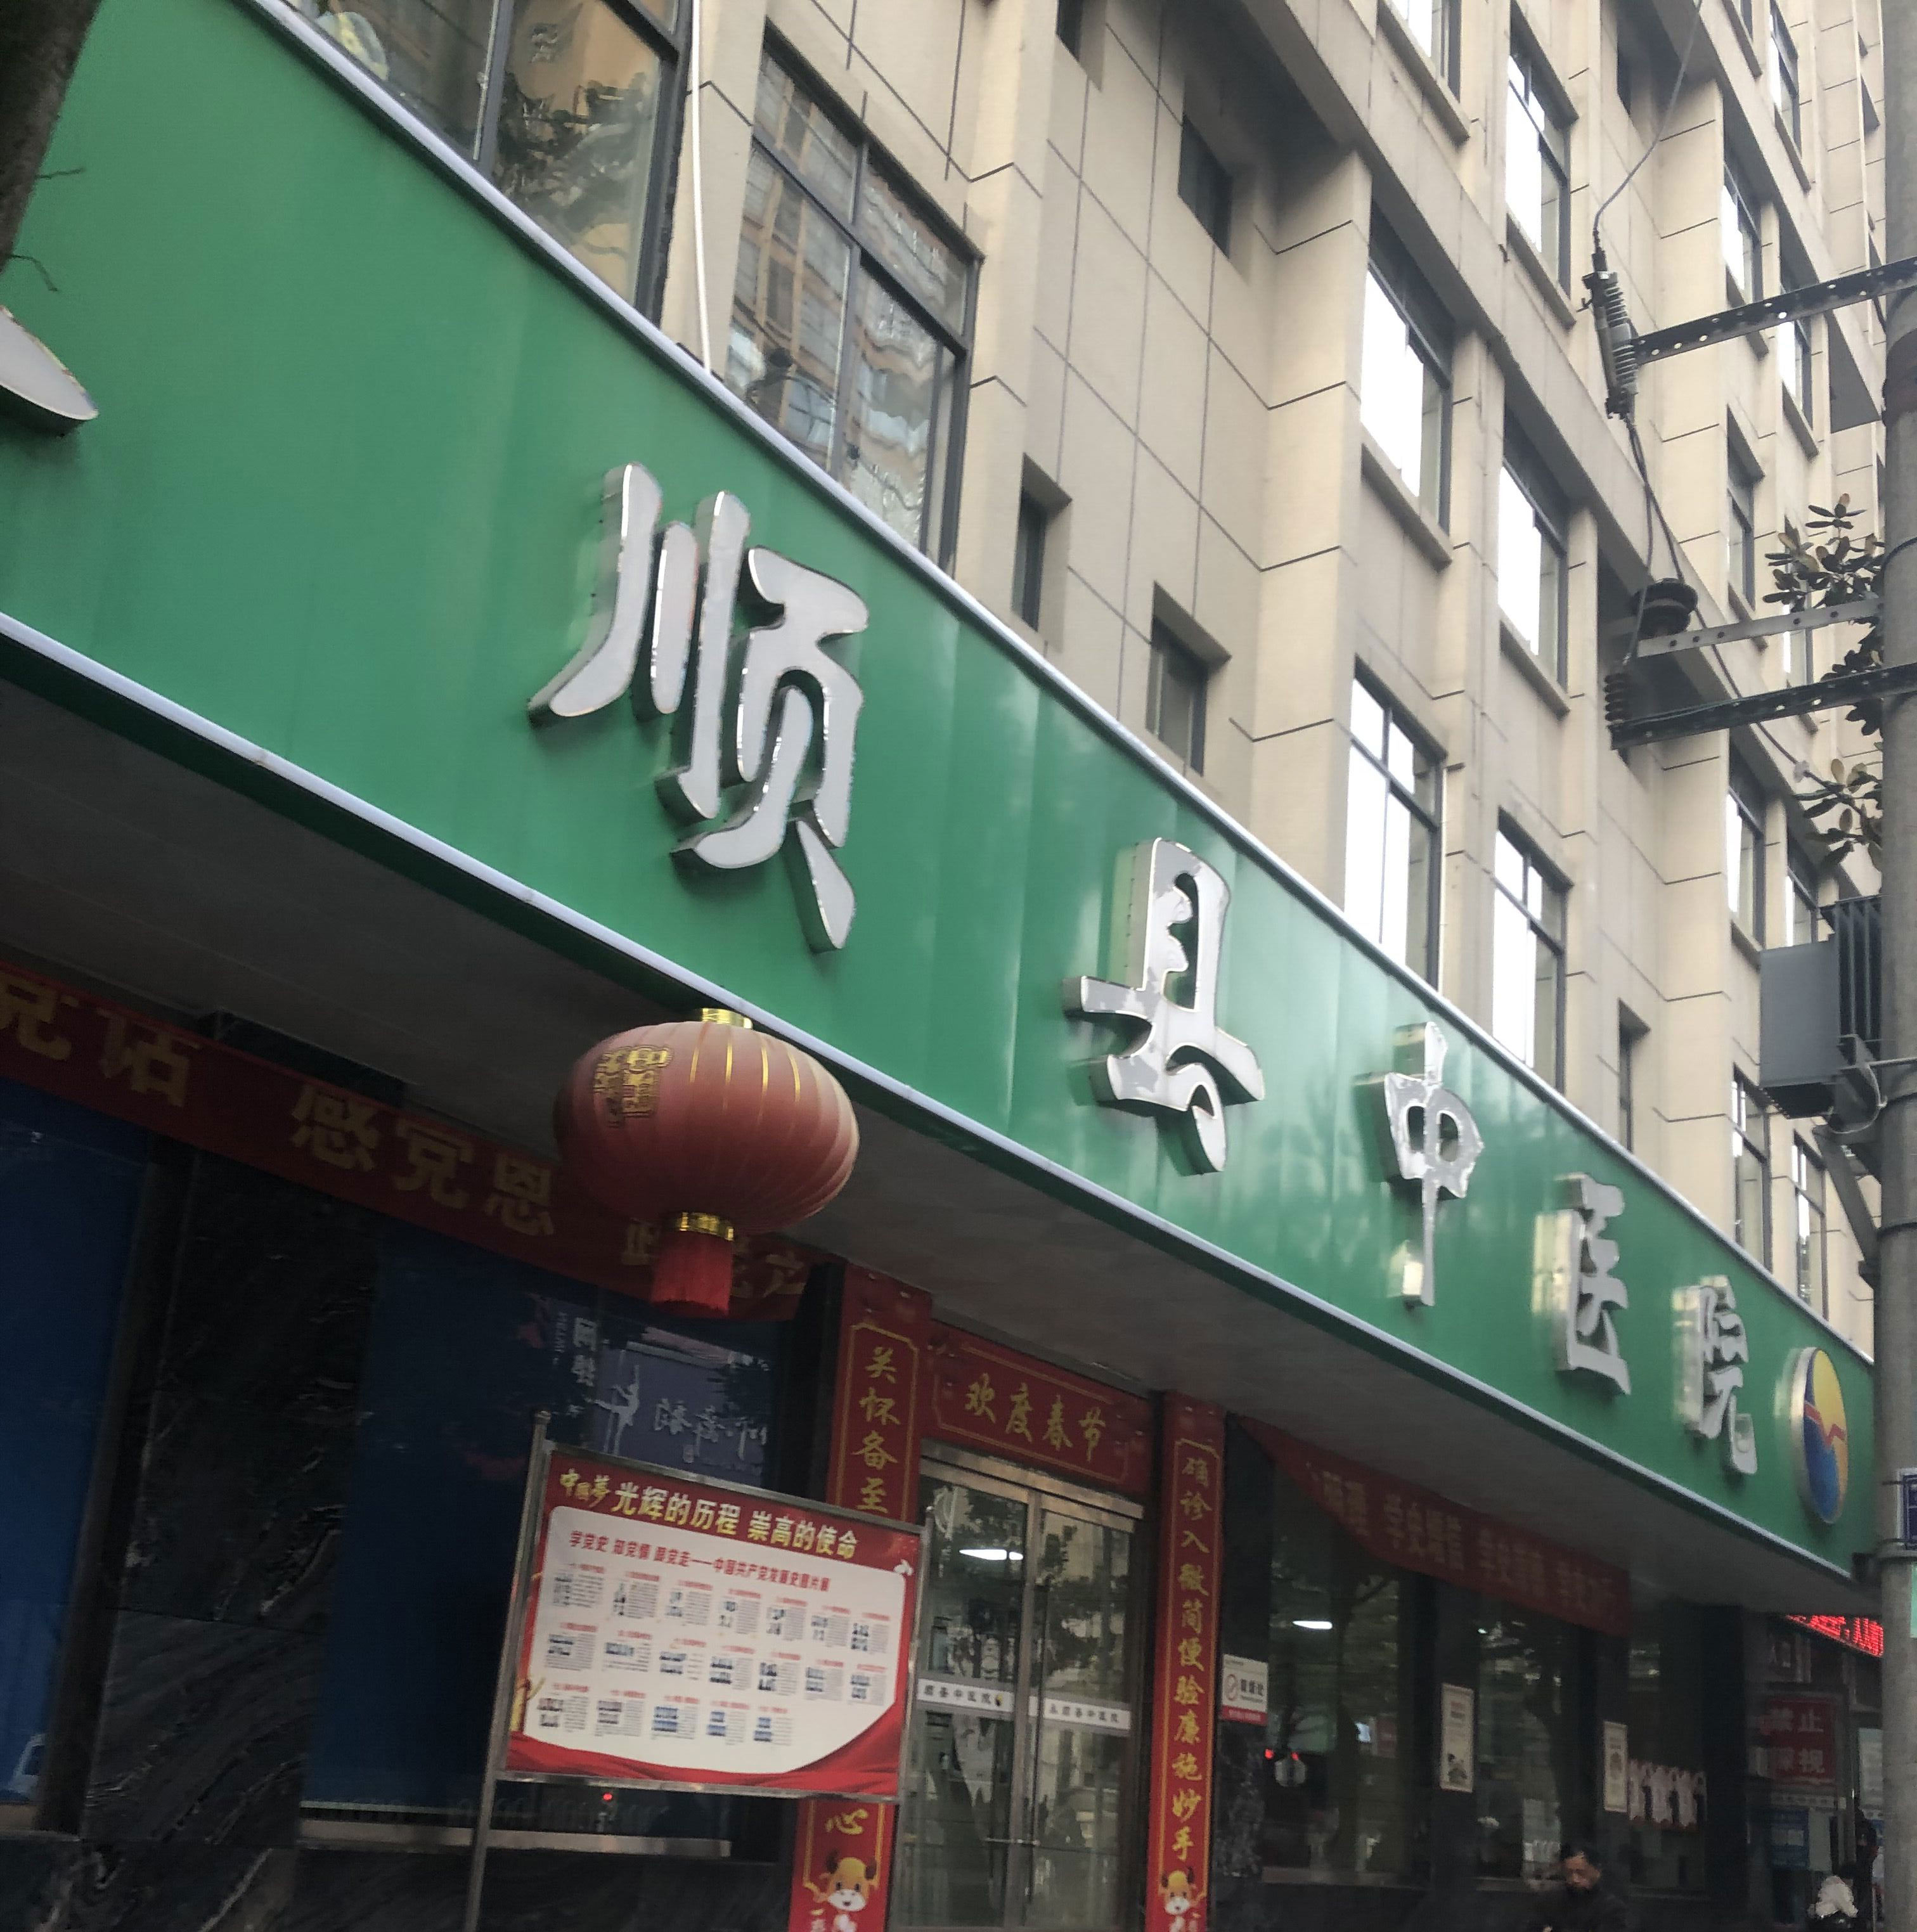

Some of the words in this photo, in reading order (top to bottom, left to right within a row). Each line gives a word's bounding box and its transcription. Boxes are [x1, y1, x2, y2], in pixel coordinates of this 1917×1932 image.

[0, 307, 1758, 1476] 顺县中医院
[852, 1347, 900, 1514] 关怀备至
[965, 1373, 1106, 1461] 欢度春节
[612, 1482, 740, 1535] 光辉的历程
[747, 1511, 858, 1559] 崇高的使命
[825, 1809, 868, 1835] 心
